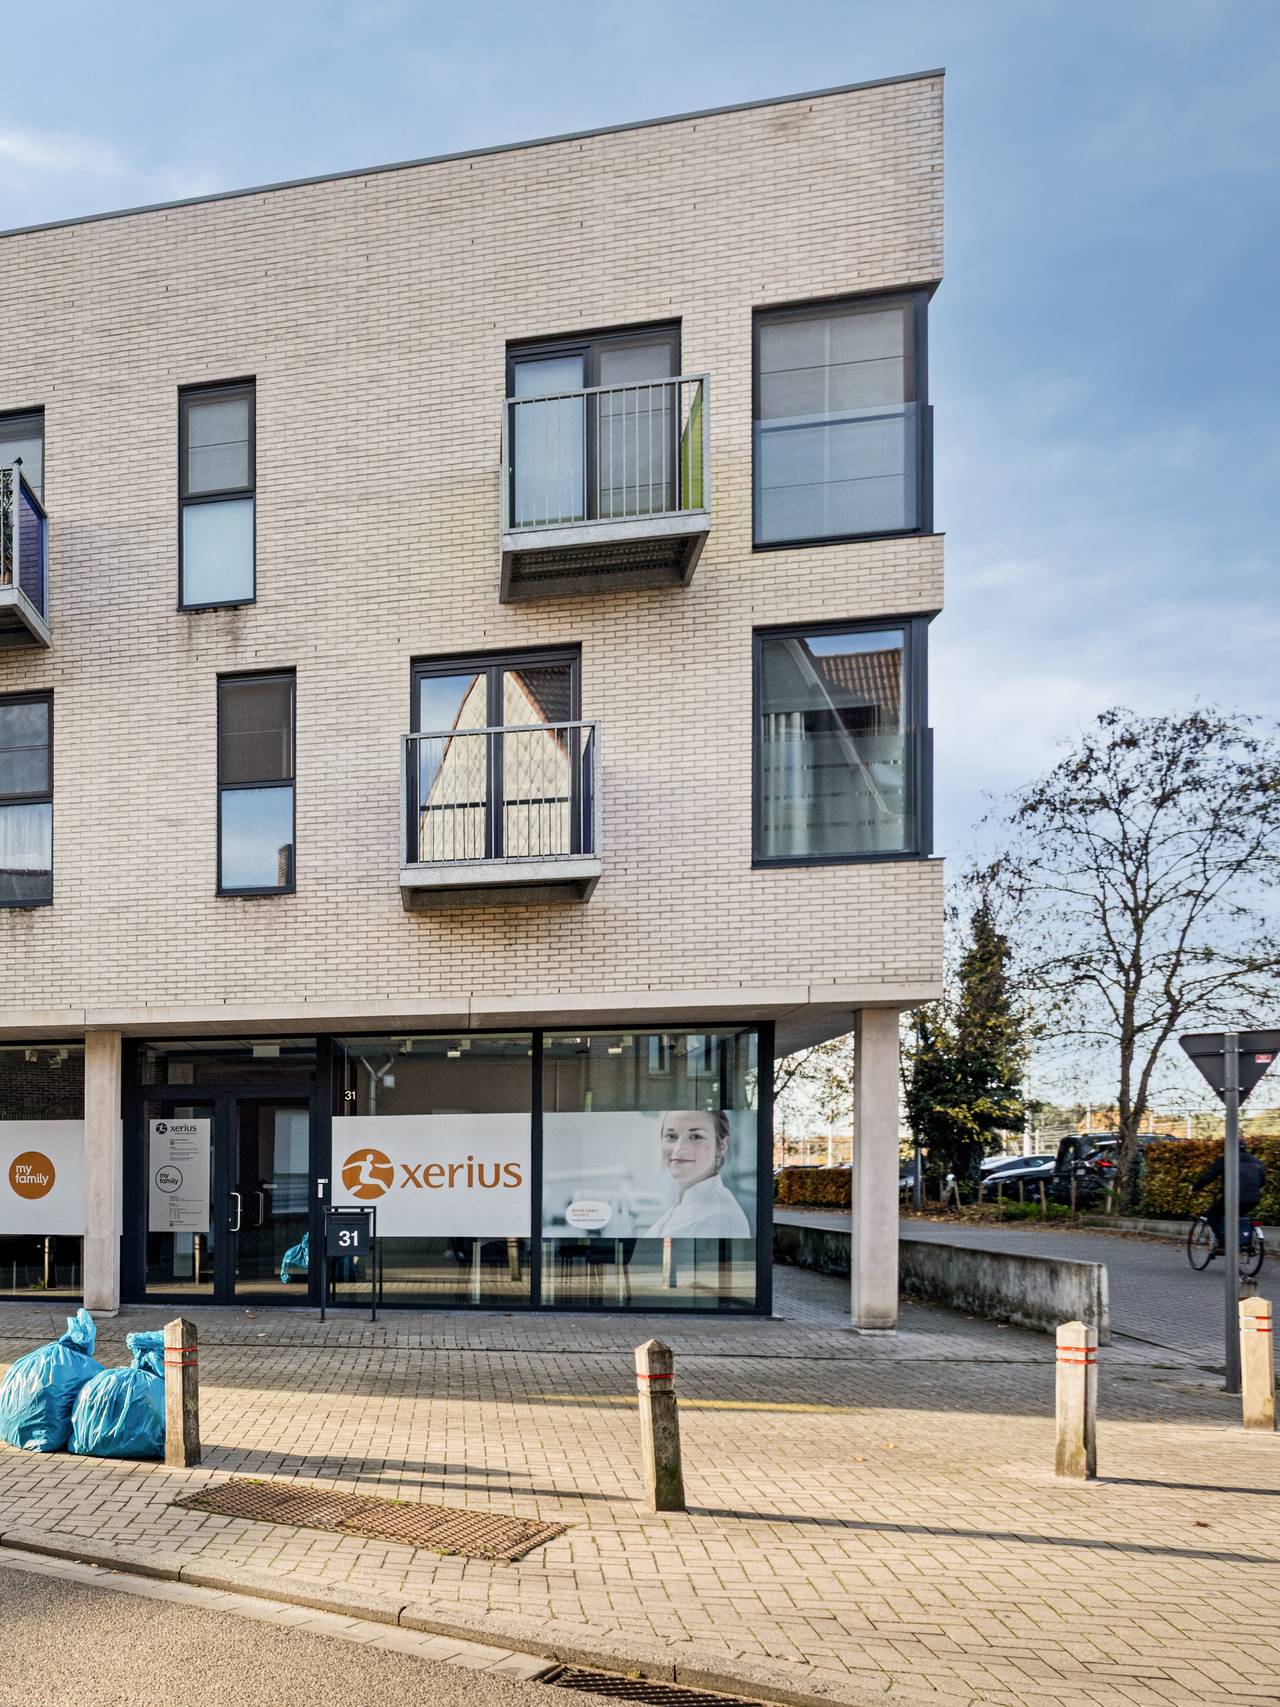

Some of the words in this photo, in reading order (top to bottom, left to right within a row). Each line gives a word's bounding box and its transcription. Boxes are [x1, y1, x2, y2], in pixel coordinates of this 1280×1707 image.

[344, 1090, 356, 1100] 31
[170, 1124, 197, 1132] xerius
[15, 1165, 32, 1175] my
[400, 1155, 522, 1189] xerius
[15, 1173, 49, 1186] family
[338, 1230, 358, 1246] 31
